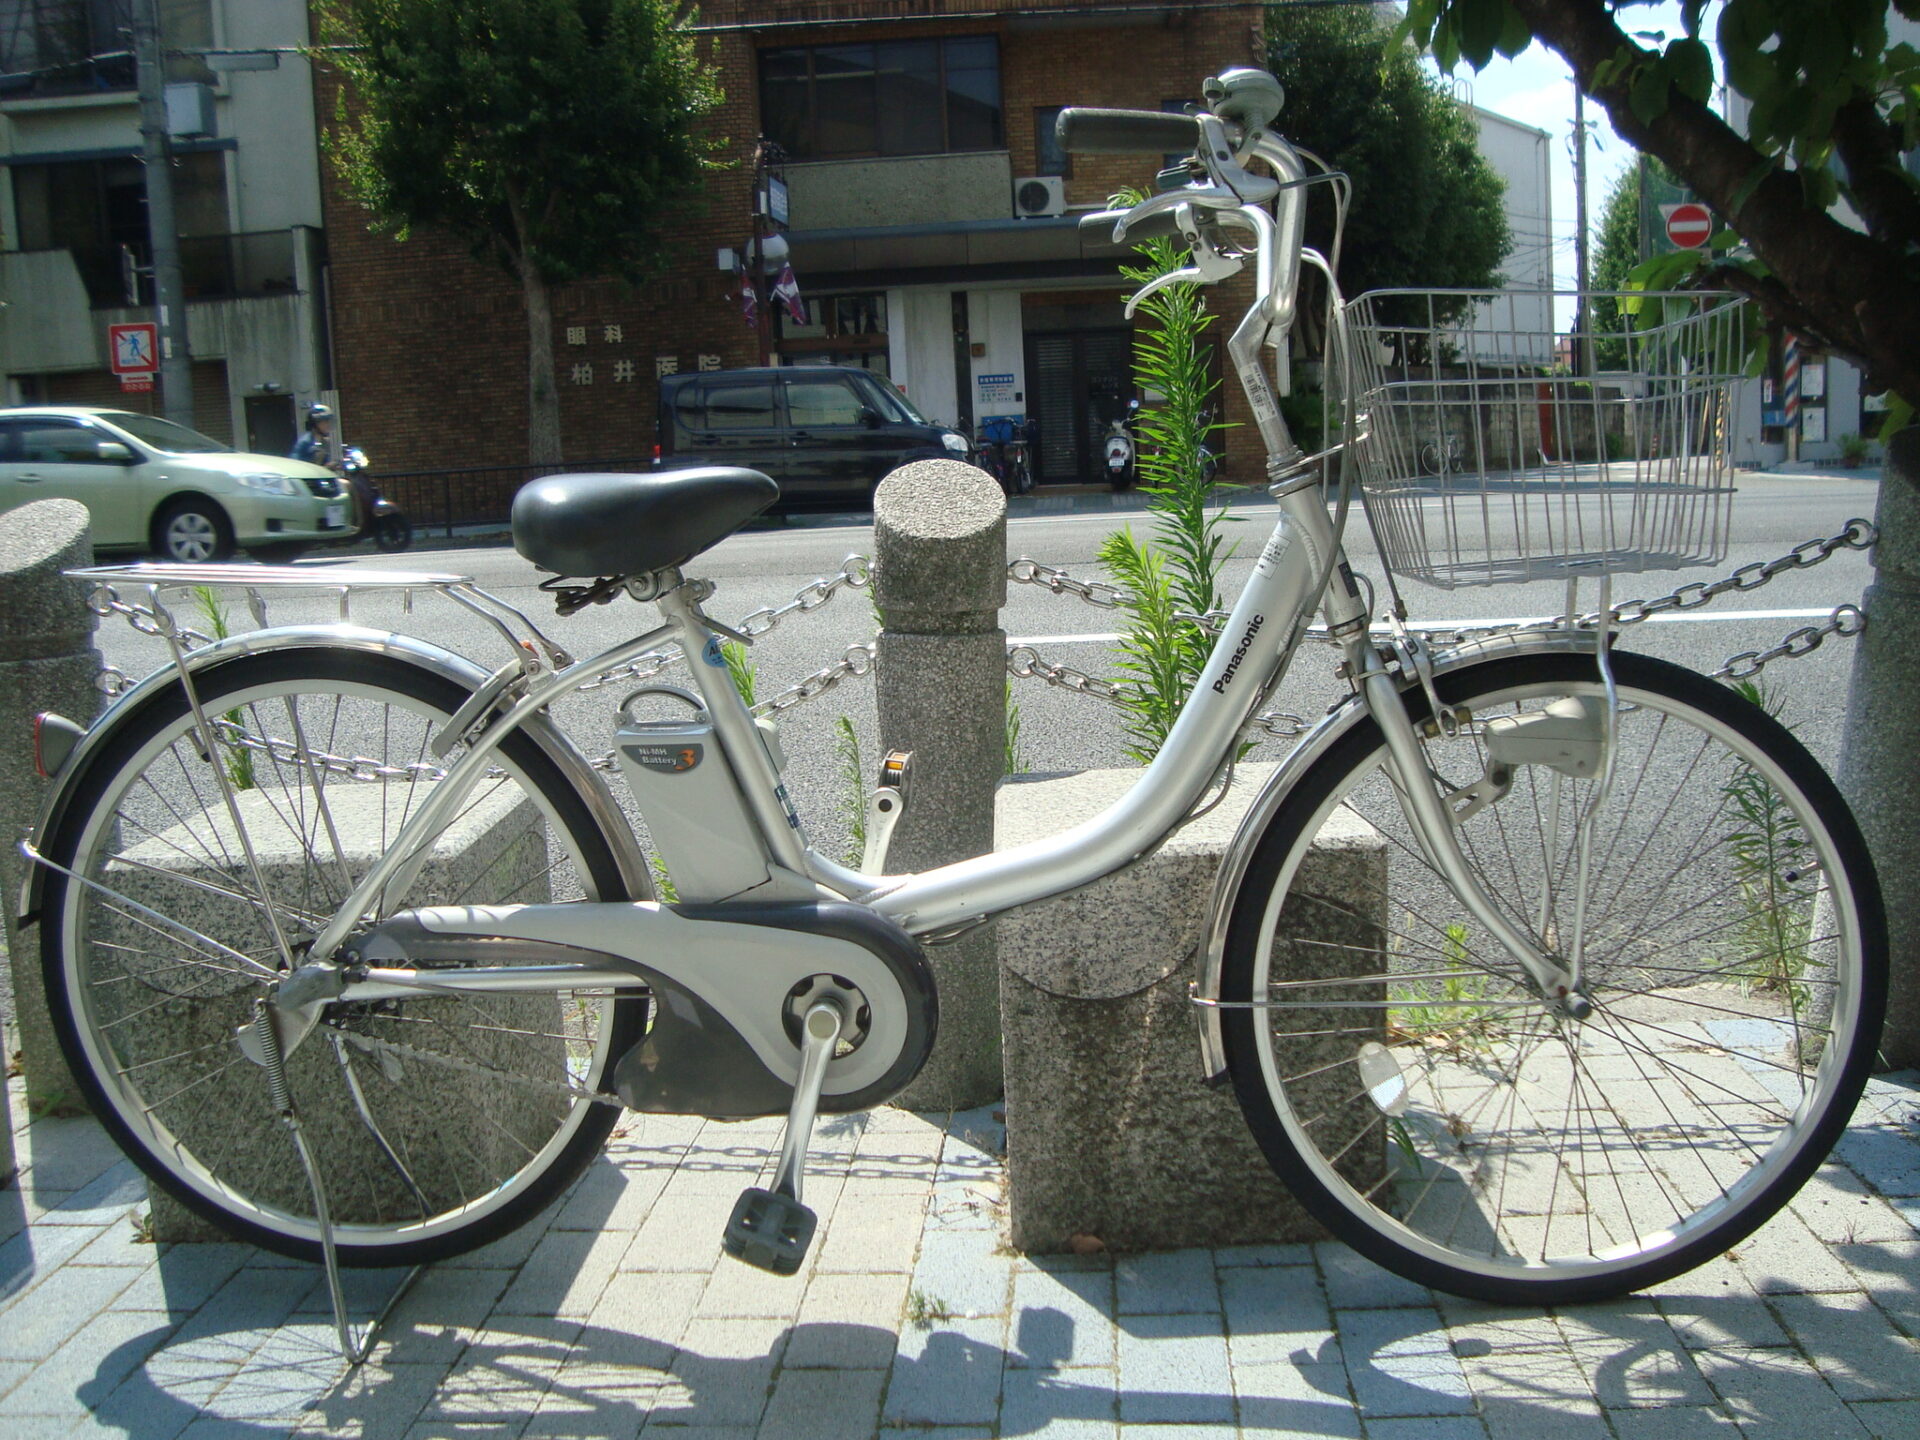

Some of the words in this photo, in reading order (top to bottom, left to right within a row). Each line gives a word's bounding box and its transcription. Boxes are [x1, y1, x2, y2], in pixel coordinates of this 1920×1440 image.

[566, 325, 623, 345] 眼科
[1212, 614, 1265, 695] Panasonic
[638, 747, 668, 756] Ni-MH
[642, 756, 677, 766] Battery
[675, 748, 696, 771] 3
